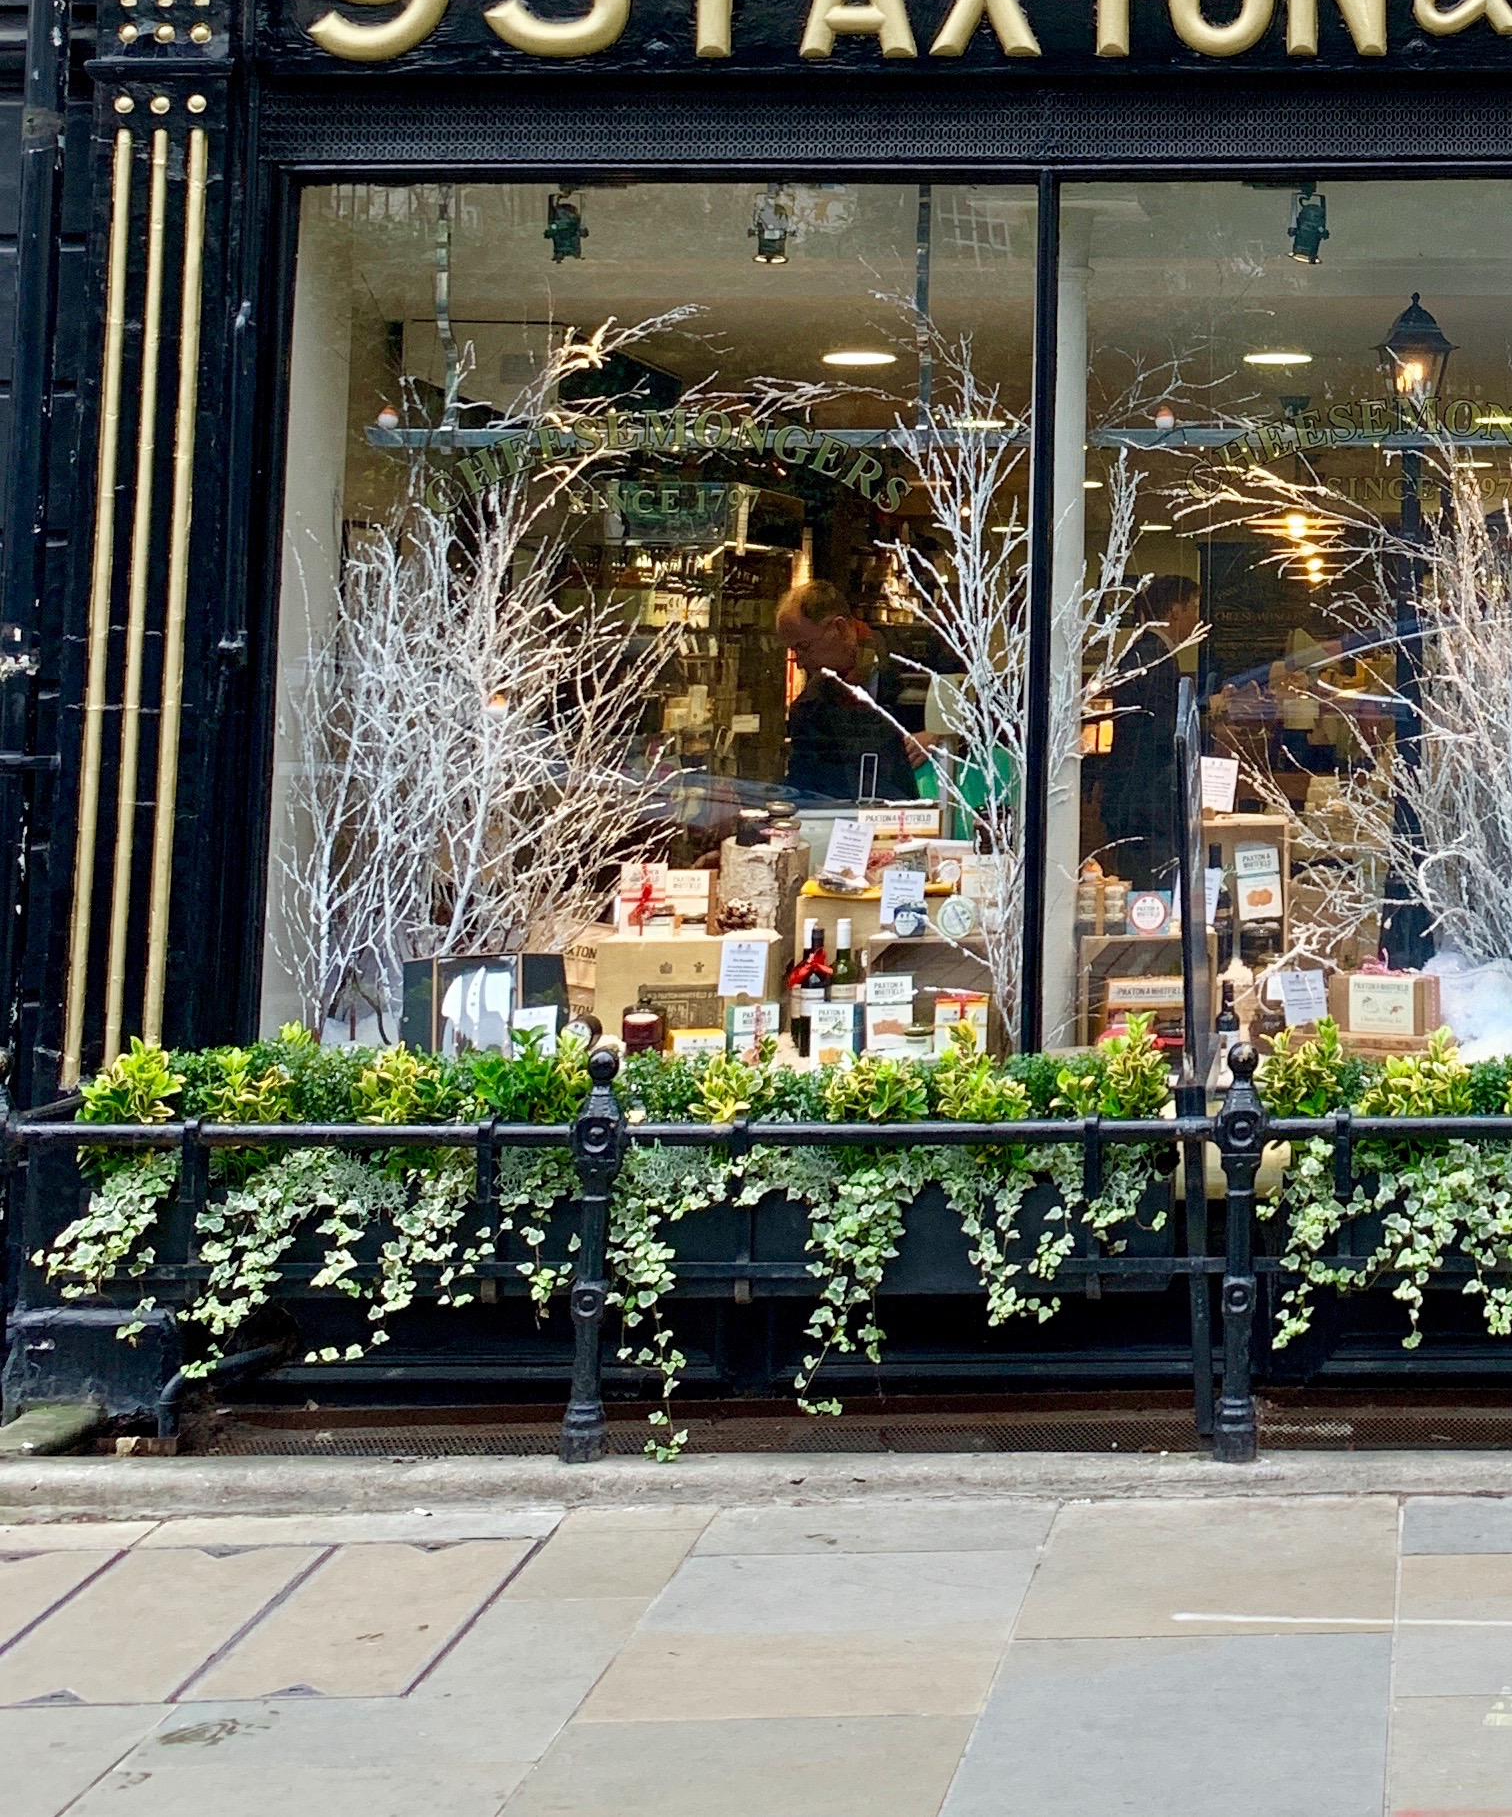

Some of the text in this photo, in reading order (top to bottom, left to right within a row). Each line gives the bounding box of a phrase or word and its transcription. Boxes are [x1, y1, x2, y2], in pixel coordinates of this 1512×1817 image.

[423, 409, 913, 515] CHEESEMONGERS
[568, 489, 762, 515] SINCE 1797
[1325, 477, 1435, 501] SINCE
